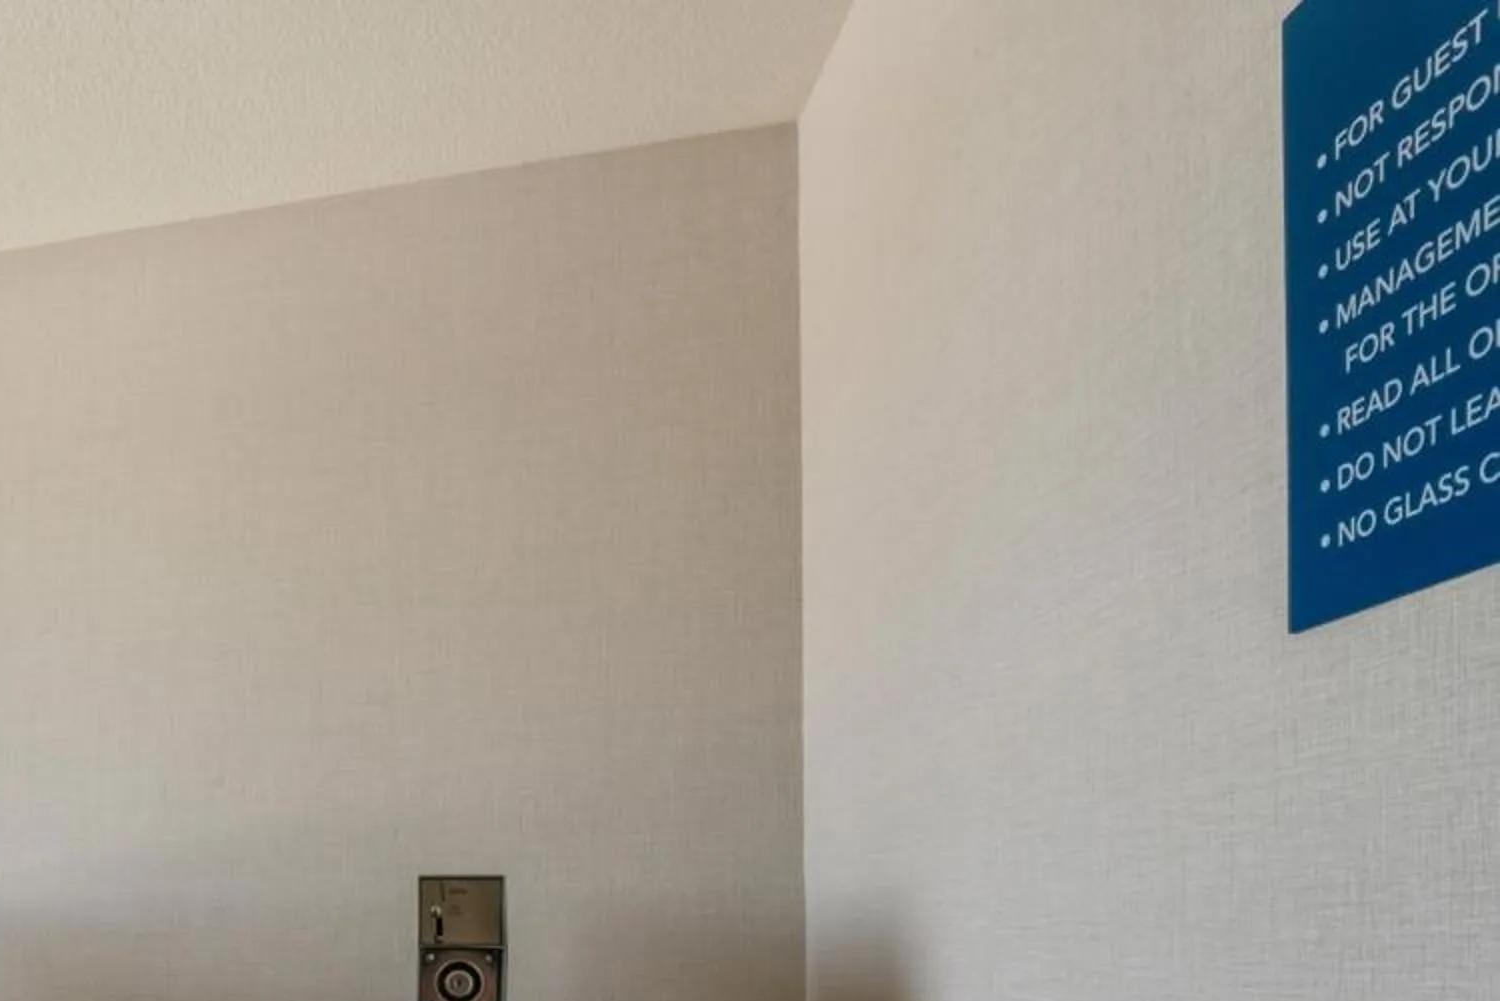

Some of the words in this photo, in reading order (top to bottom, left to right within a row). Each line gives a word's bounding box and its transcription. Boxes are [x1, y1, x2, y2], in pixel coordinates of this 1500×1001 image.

[1335, 99, 1384, 161] FOR
[1391, 8, 1489, 110] GUEST
[1335, 151, 1391, 217] NOT
[1335, 218, 1381, 271] USE
[1387, 188, 1421, 236] AT
[1427, 128, 1500, 202] YOU
[1335, 194, 1500, 329] MANAGEME
[1337, 377, 1403, 435] READ
[1409, 347, 1461, 396] ALL
[1468, 319, 1500, 360] O
[1345, 321, 1395, 374] FOR
[1401, 281, 1457, 336] THE
[1337, 452, 1375, 491] DO
[1382, 415, 1443, 469] NOT
[1337, 508, 1377, 547] NO
[1383, 465, 1470, 525] GLASS
